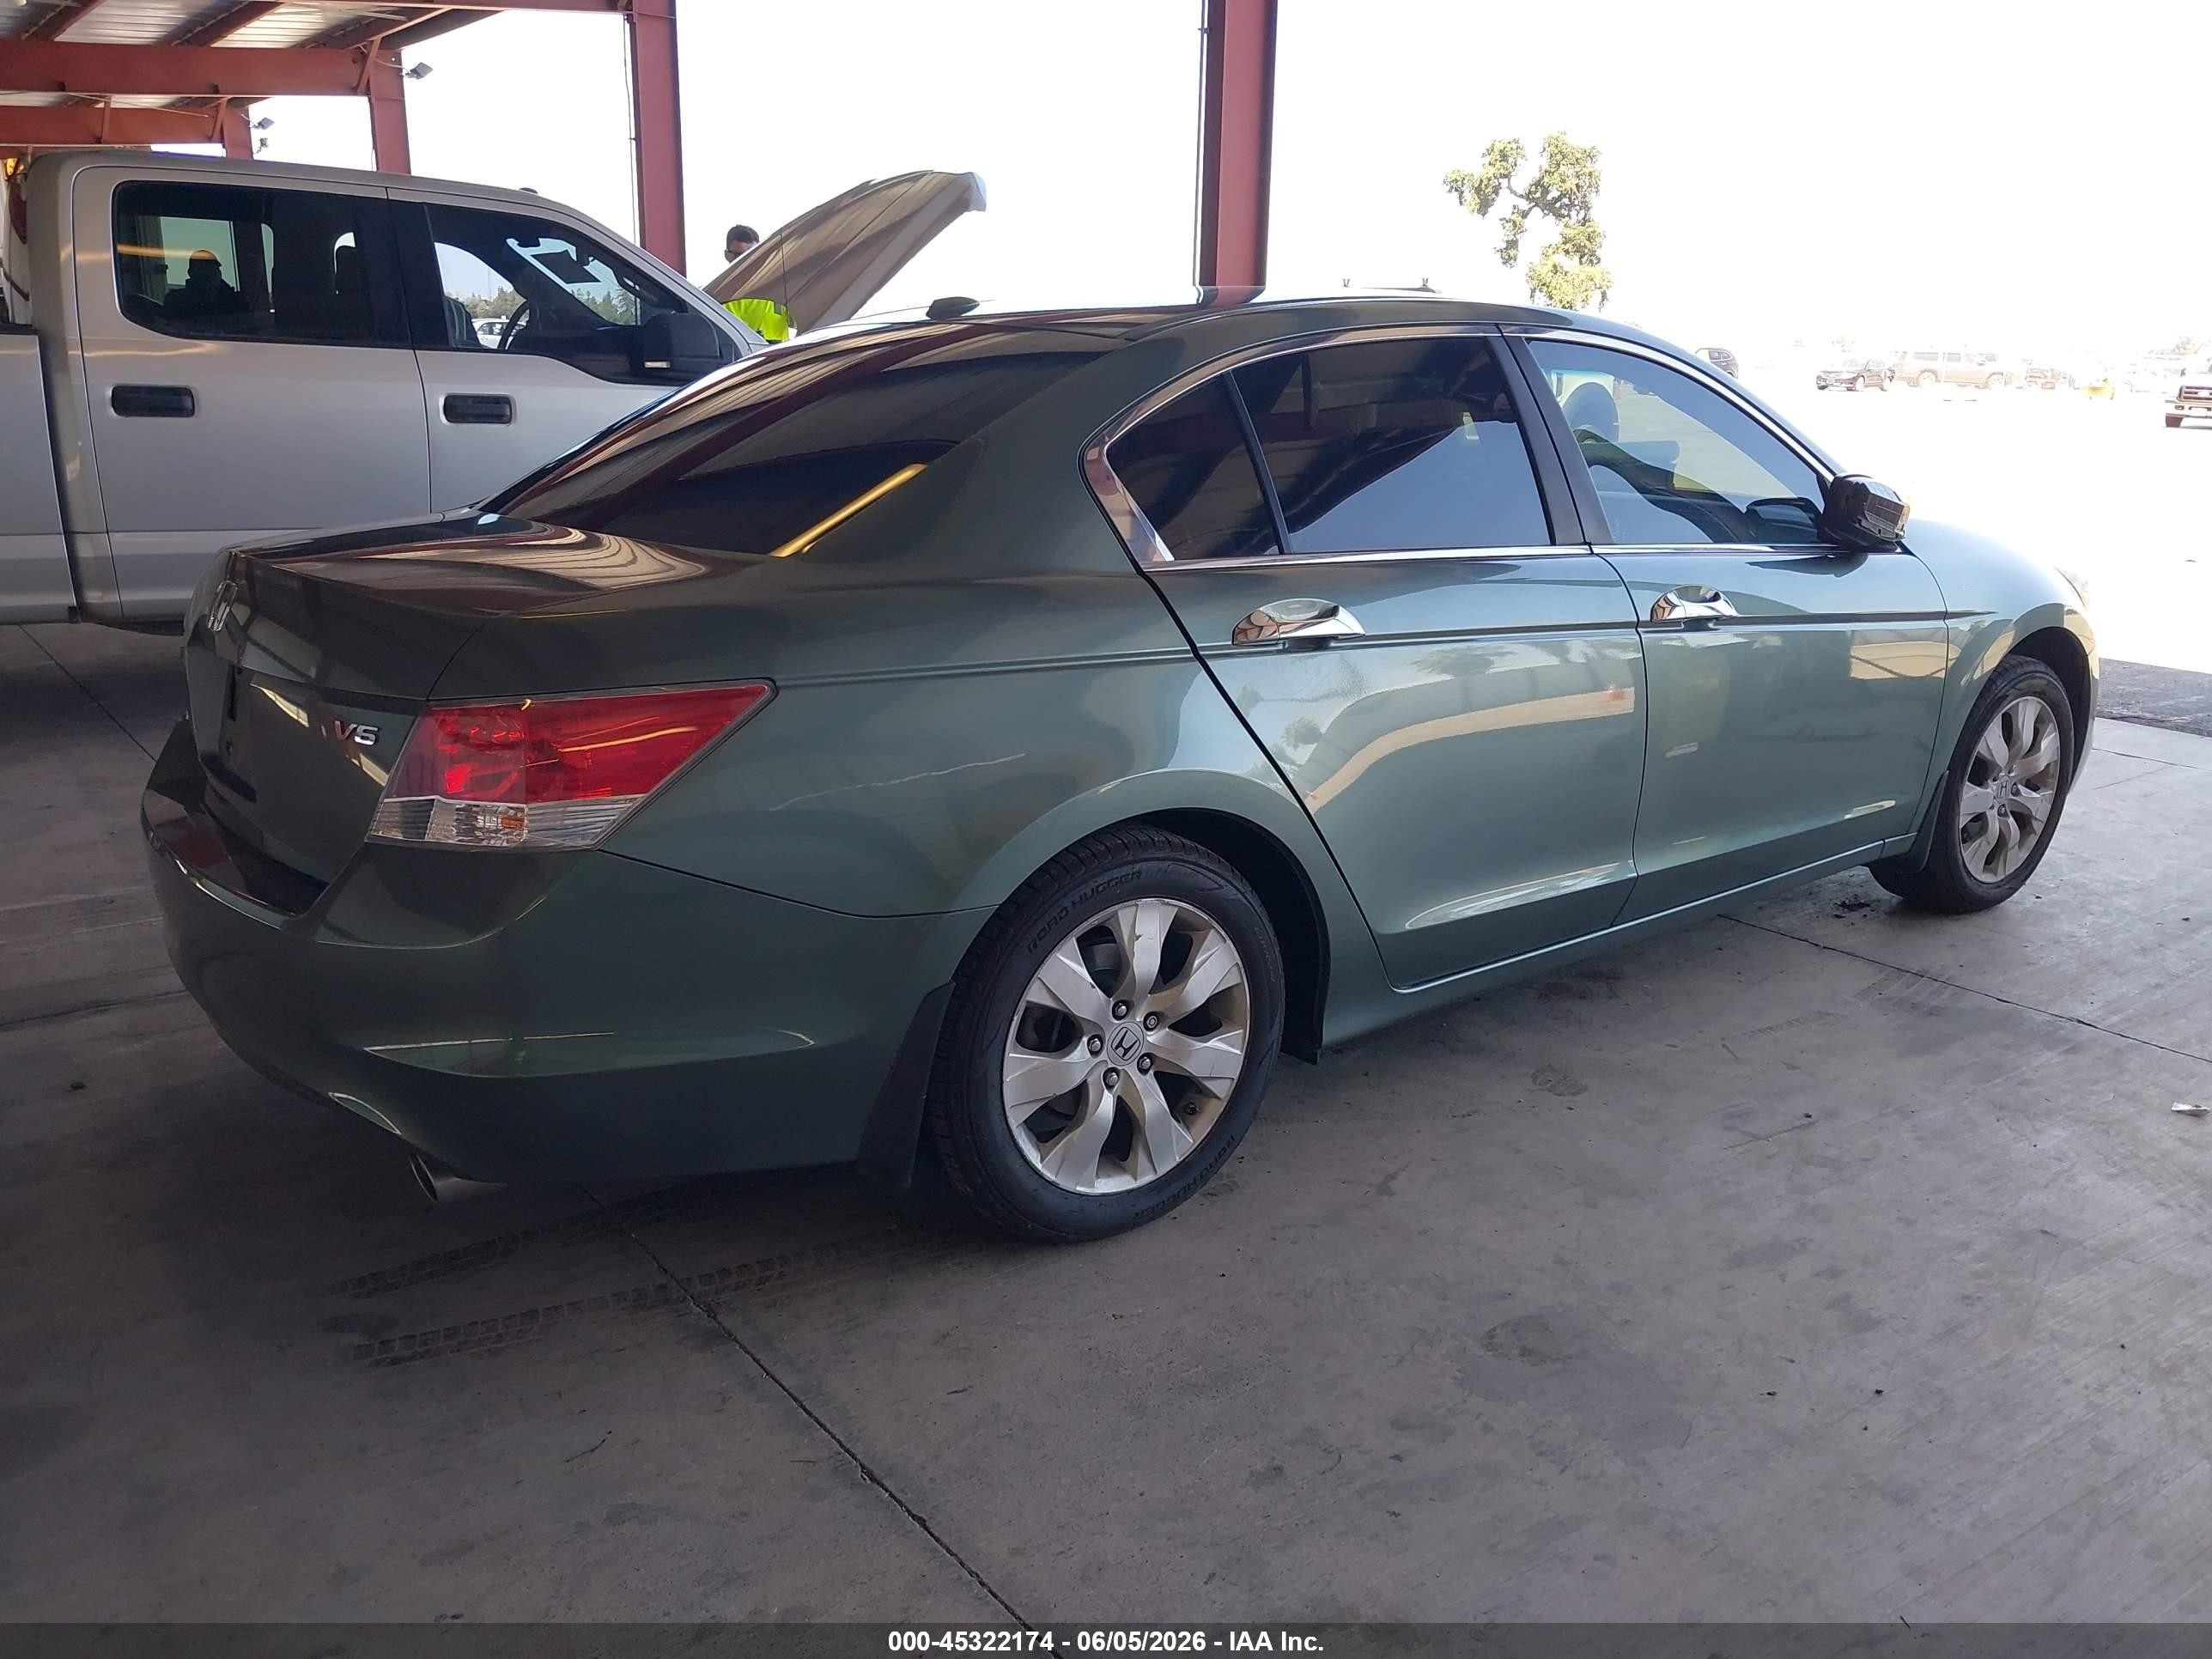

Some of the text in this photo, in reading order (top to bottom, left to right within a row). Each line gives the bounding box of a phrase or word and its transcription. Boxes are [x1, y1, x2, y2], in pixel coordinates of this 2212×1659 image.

[334, 720, 379, 746] V6
[1027, 870, 1143, 954] ROAD HUGGER
